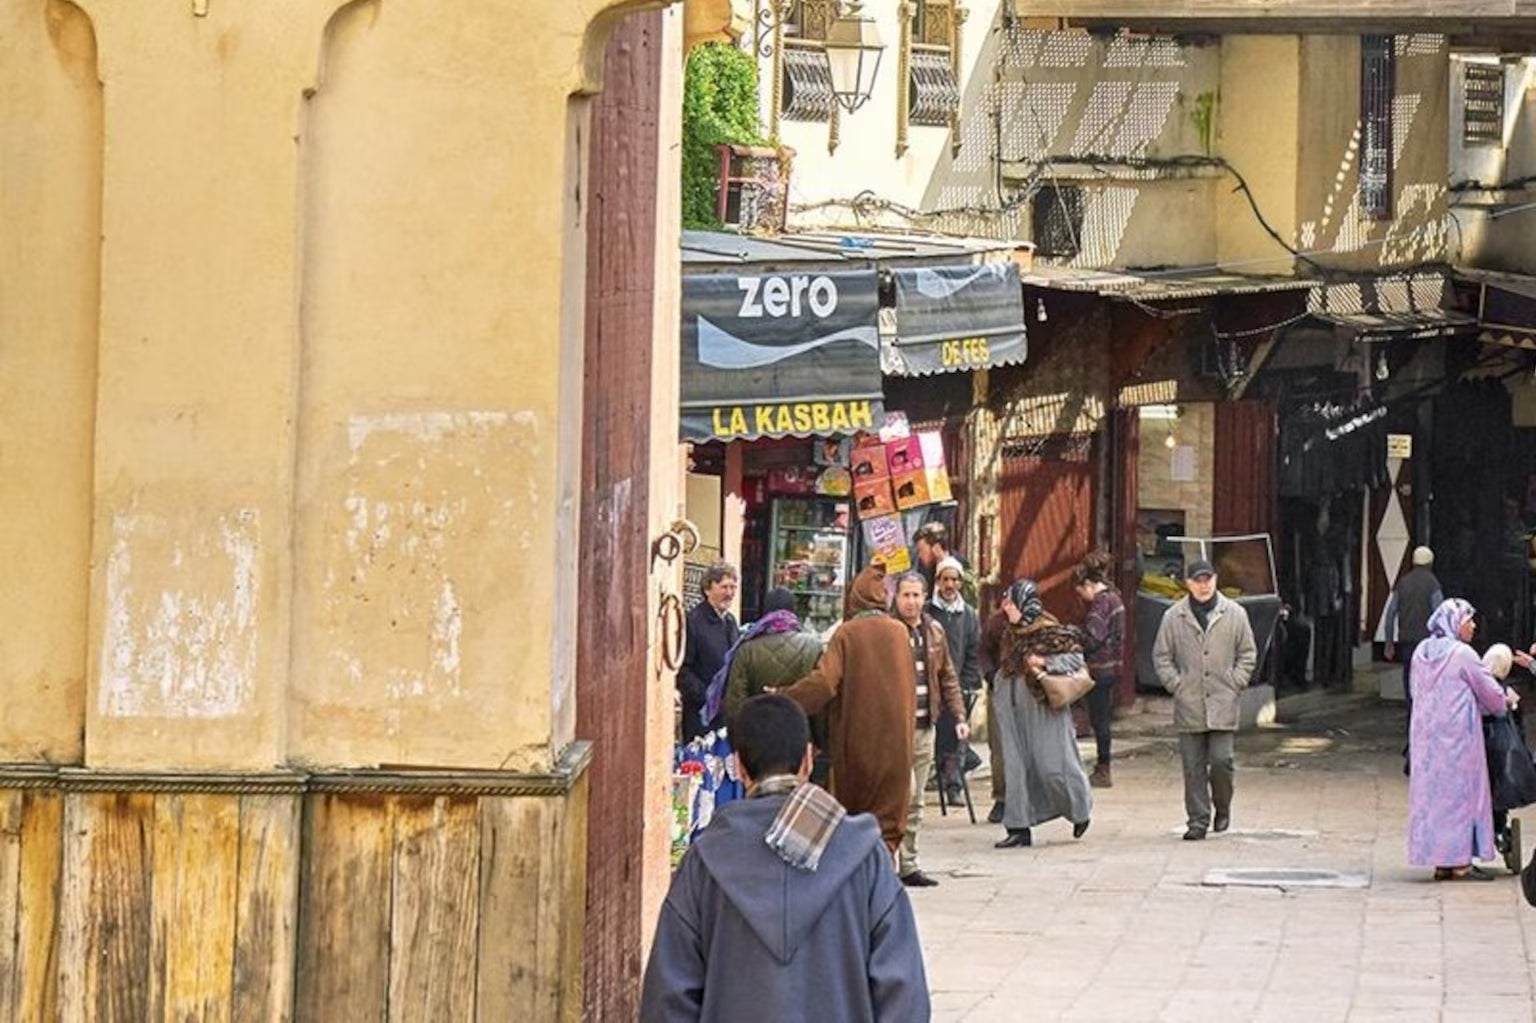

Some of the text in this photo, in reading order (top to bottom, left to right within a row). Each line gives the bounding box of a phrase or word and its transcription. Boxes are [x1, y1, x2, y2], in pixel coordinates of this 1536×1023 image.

[737, 275, 838, 318] zero
[963, 337, 990, 363] FES
[712, 405, 750, 437] LA
[754, 399, 874, 433] KASBAH
